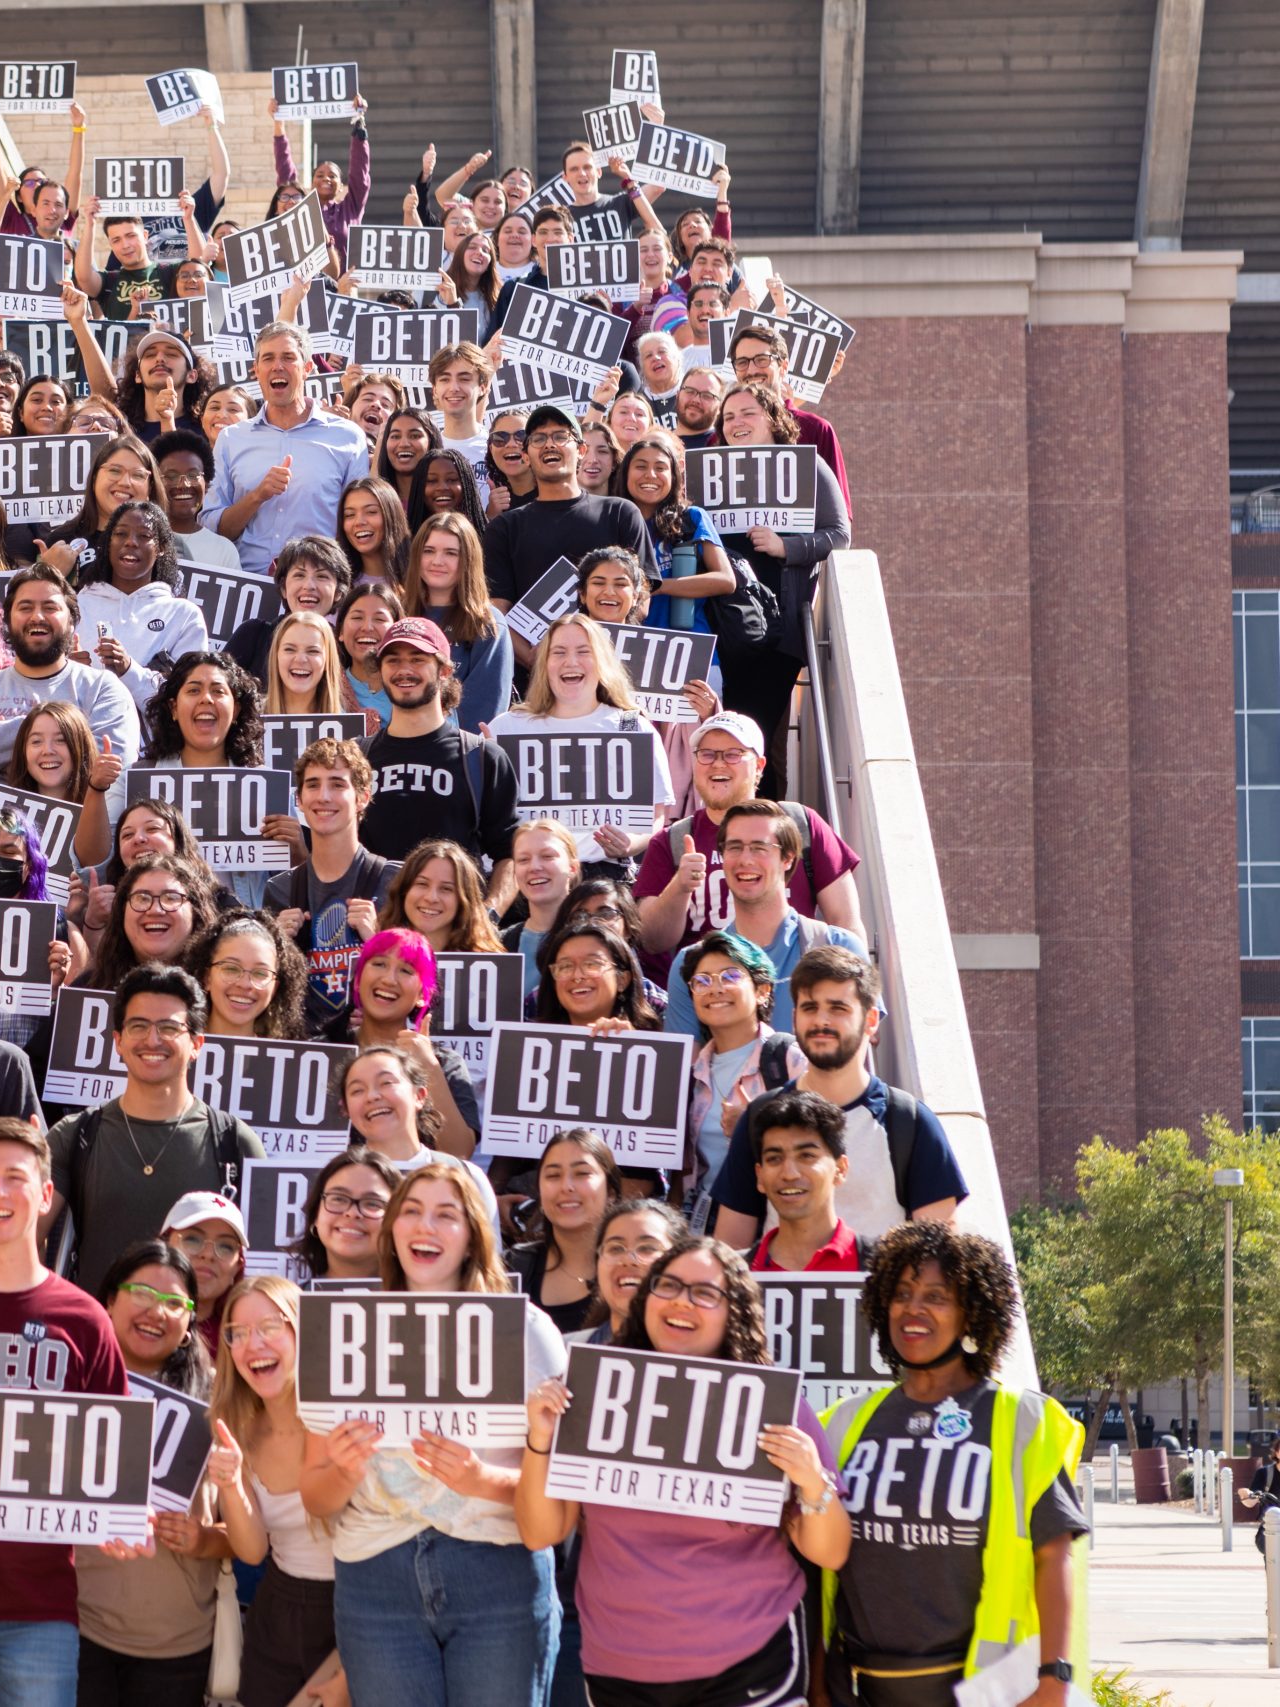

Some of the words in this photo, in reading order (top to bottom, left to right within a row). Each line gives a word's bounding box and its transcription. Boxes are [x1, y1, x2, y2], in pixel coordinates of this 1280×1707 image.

[3, 65, 64, 98] BETO
[284, 67, 347, 104] BETO
[623, 54, 654, 91] BE
[7, 101, 28, 110] FOR
[34, 101, 58, 110] TEXAS
[291, 106, 308, 117] FOR
[312, 104, 342, 116] TEXAS
[589, 104, 636, 150] BETO
[647, 128, 715, 178] BETO
[107, 160, 172, 198] BETO
[649, 170, 668, 182] FOR
[671, 174, 702, 192] TEXAS
[112, 202, 131, 212] FOR
[136, 202, 167, 212] TEXAS
[240, 203, 316, 280] BETO
[360, 229, 430, 270] BETO
[365, 273, 384, 284] FOR
[391, 274, 422, 285] TEXAS
[559, 244, 628, 286] BETO
[255, 276, 277, 294] FOR
[519, 292, 613, 361] BETO
[520, 344, 543, 362] FOR
[550, 352, 590, 377] TEXAS
[703, 451, 797, 507] BETO
[6, 502, 30, 517] FOR
[39, 498, 83, 516] TEXAS
[713, 513, 736, 528] FOR
[746, 511, 788, 527] TEXAS
[519, 738, 632, 802] BETO
[572, 808, 622, 827] TEXAS
[202, 845, 256, 864] TEXAS
[80, 1078, 114, 1099] FOR
[194, 1043, 329, 1125] BETO
[517, 1037, 658, 1120] BETO
[24, 1322, 45, 1338] BETO
[329, 1302, 493, 1398] BETO
[403, 1409, 477, 1436] TEXAS
[587, 1357, 766, 1470] BETO
[596, 1466, 638, 1497] FOR
[657, 1473, 733, 1509] TEXAS
[842, 1437, 993, 1521] BETO
[25, 1506, 99, 1533] TEXAS
[863, 1520, 894, 1544] FOR
[900, 1522, 950, 1546] TEXAS
